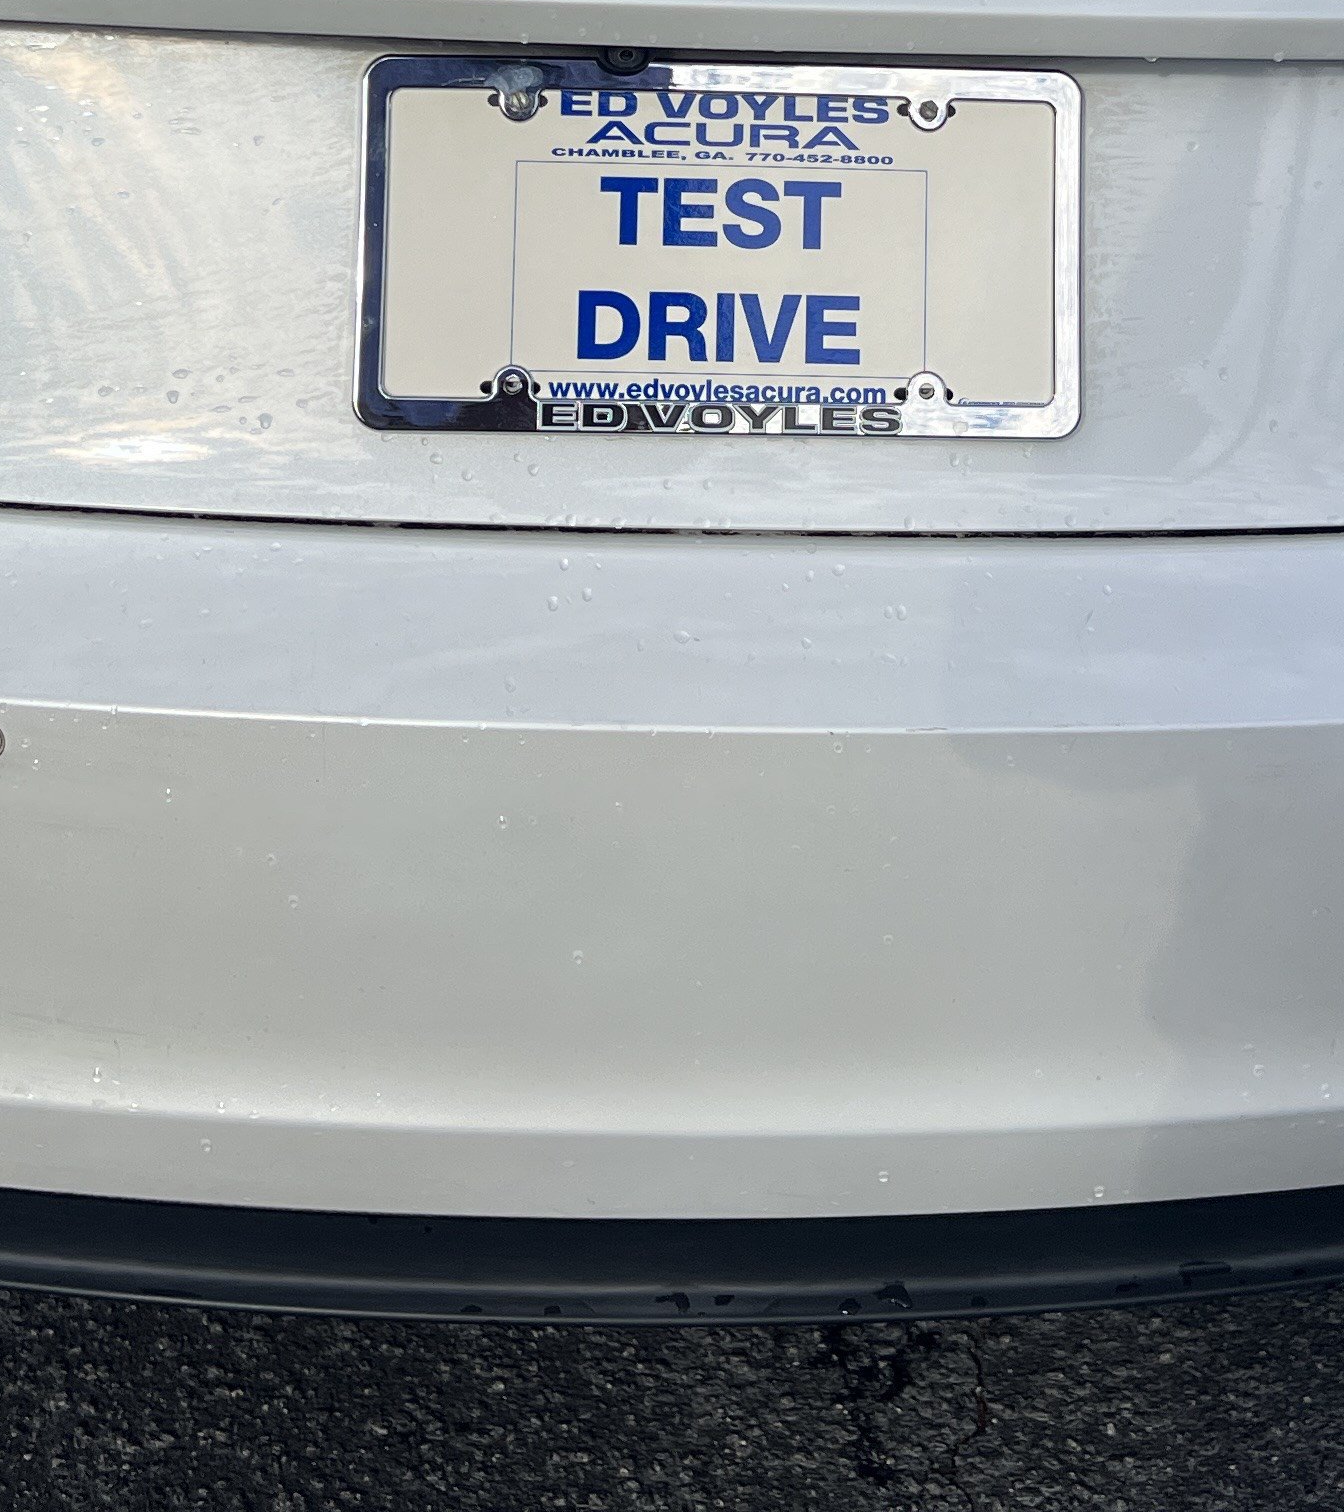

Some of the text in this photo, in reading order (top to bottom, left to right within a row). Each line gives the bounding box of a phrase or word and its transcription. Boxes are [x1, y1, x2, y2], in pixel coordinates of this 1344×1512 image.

[560, 90, 890, 124] ED VOYLES
[585, 120, 860, 151] ACURA
[551, 147, 894, 165] CHAMBLEE, GA. 770-452-8800
[600, 176, 842, 250] TEST
[577, 290, 860, 365] DRIVE
[548, 379, 886, 404] www.edvoylesacura.com
[537, 402, 903, 435] ED VOYLES
